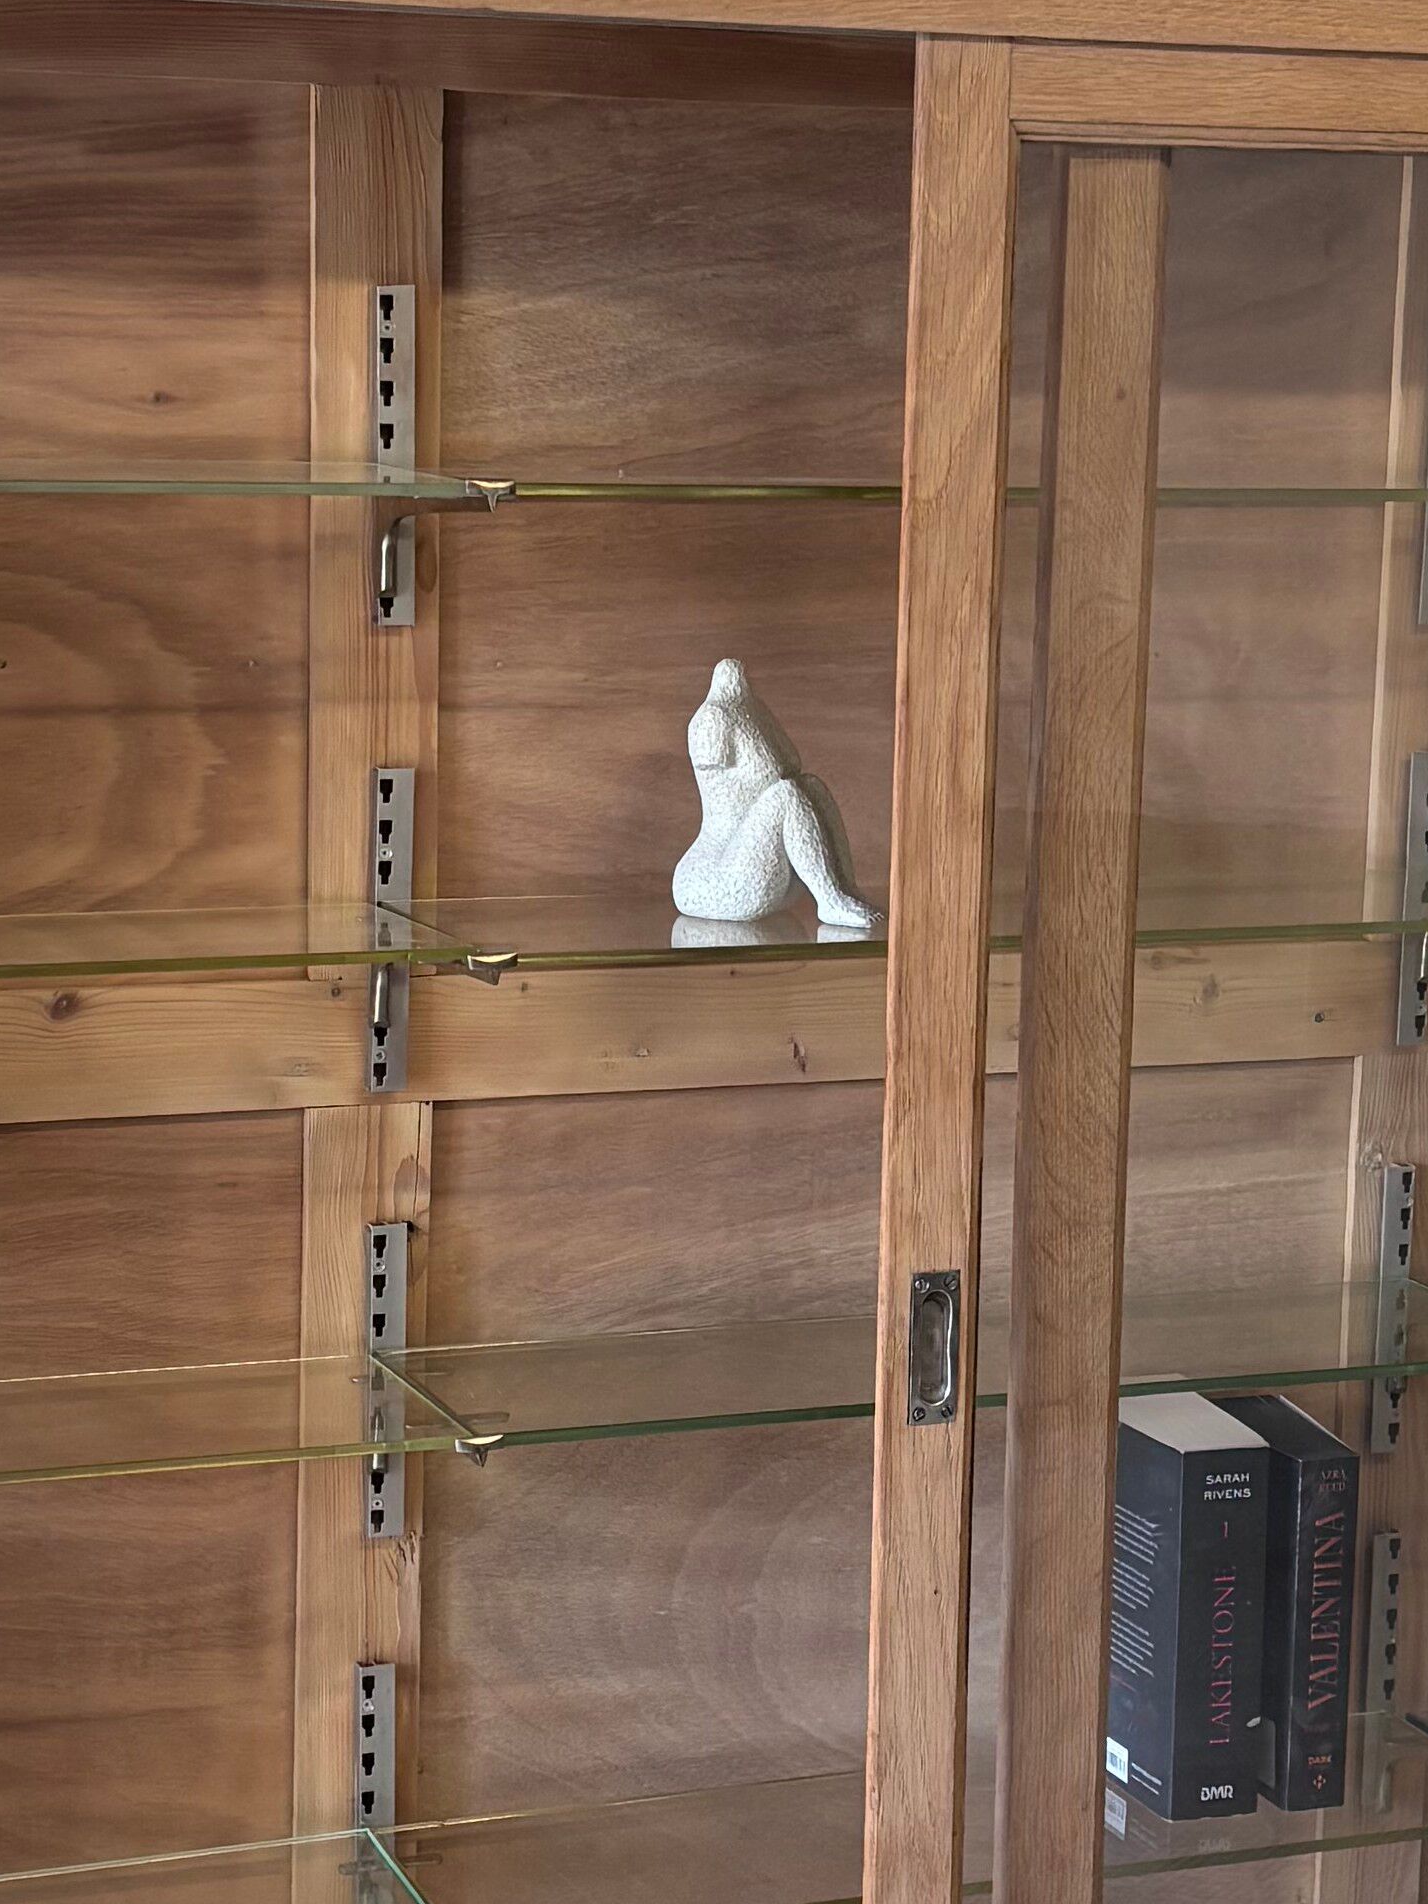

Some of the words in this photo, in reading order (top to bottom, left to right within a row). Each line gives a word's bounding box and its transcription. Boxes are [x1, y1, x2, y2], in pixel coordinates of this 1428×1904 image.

[1205, 1472, 1250, 1485] SARAH
[1203, 1487, 1252, 1501] RIVENS
[1307, 1510, 1345, 1711] VALENTINA
[1200, 1784, 1234, 1801] DMR
